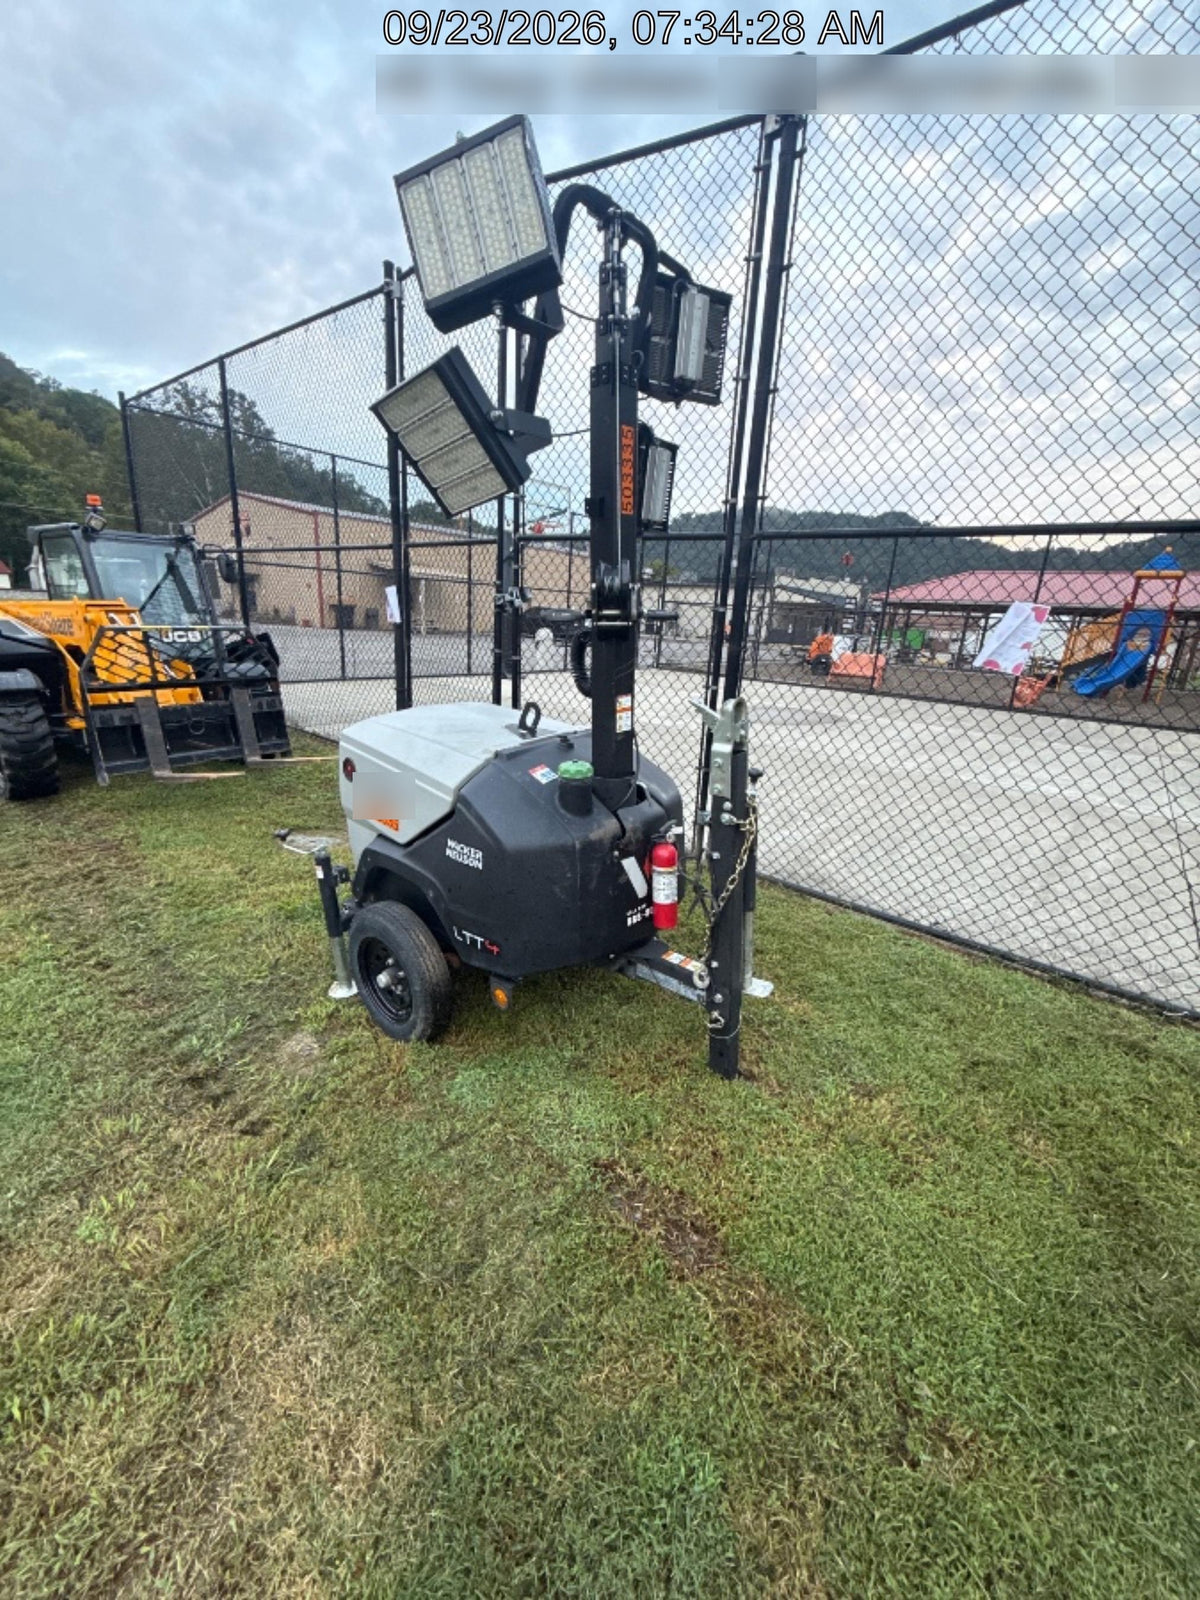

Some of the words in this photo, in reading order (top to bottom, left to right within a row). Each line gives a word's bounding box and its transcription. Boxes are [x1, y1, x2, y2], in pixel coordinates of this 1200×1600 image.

[622, 427, 632, 513] 503335
[162, 630, 201, 643] JCB
[453, 926, 500, 955] LTT4
